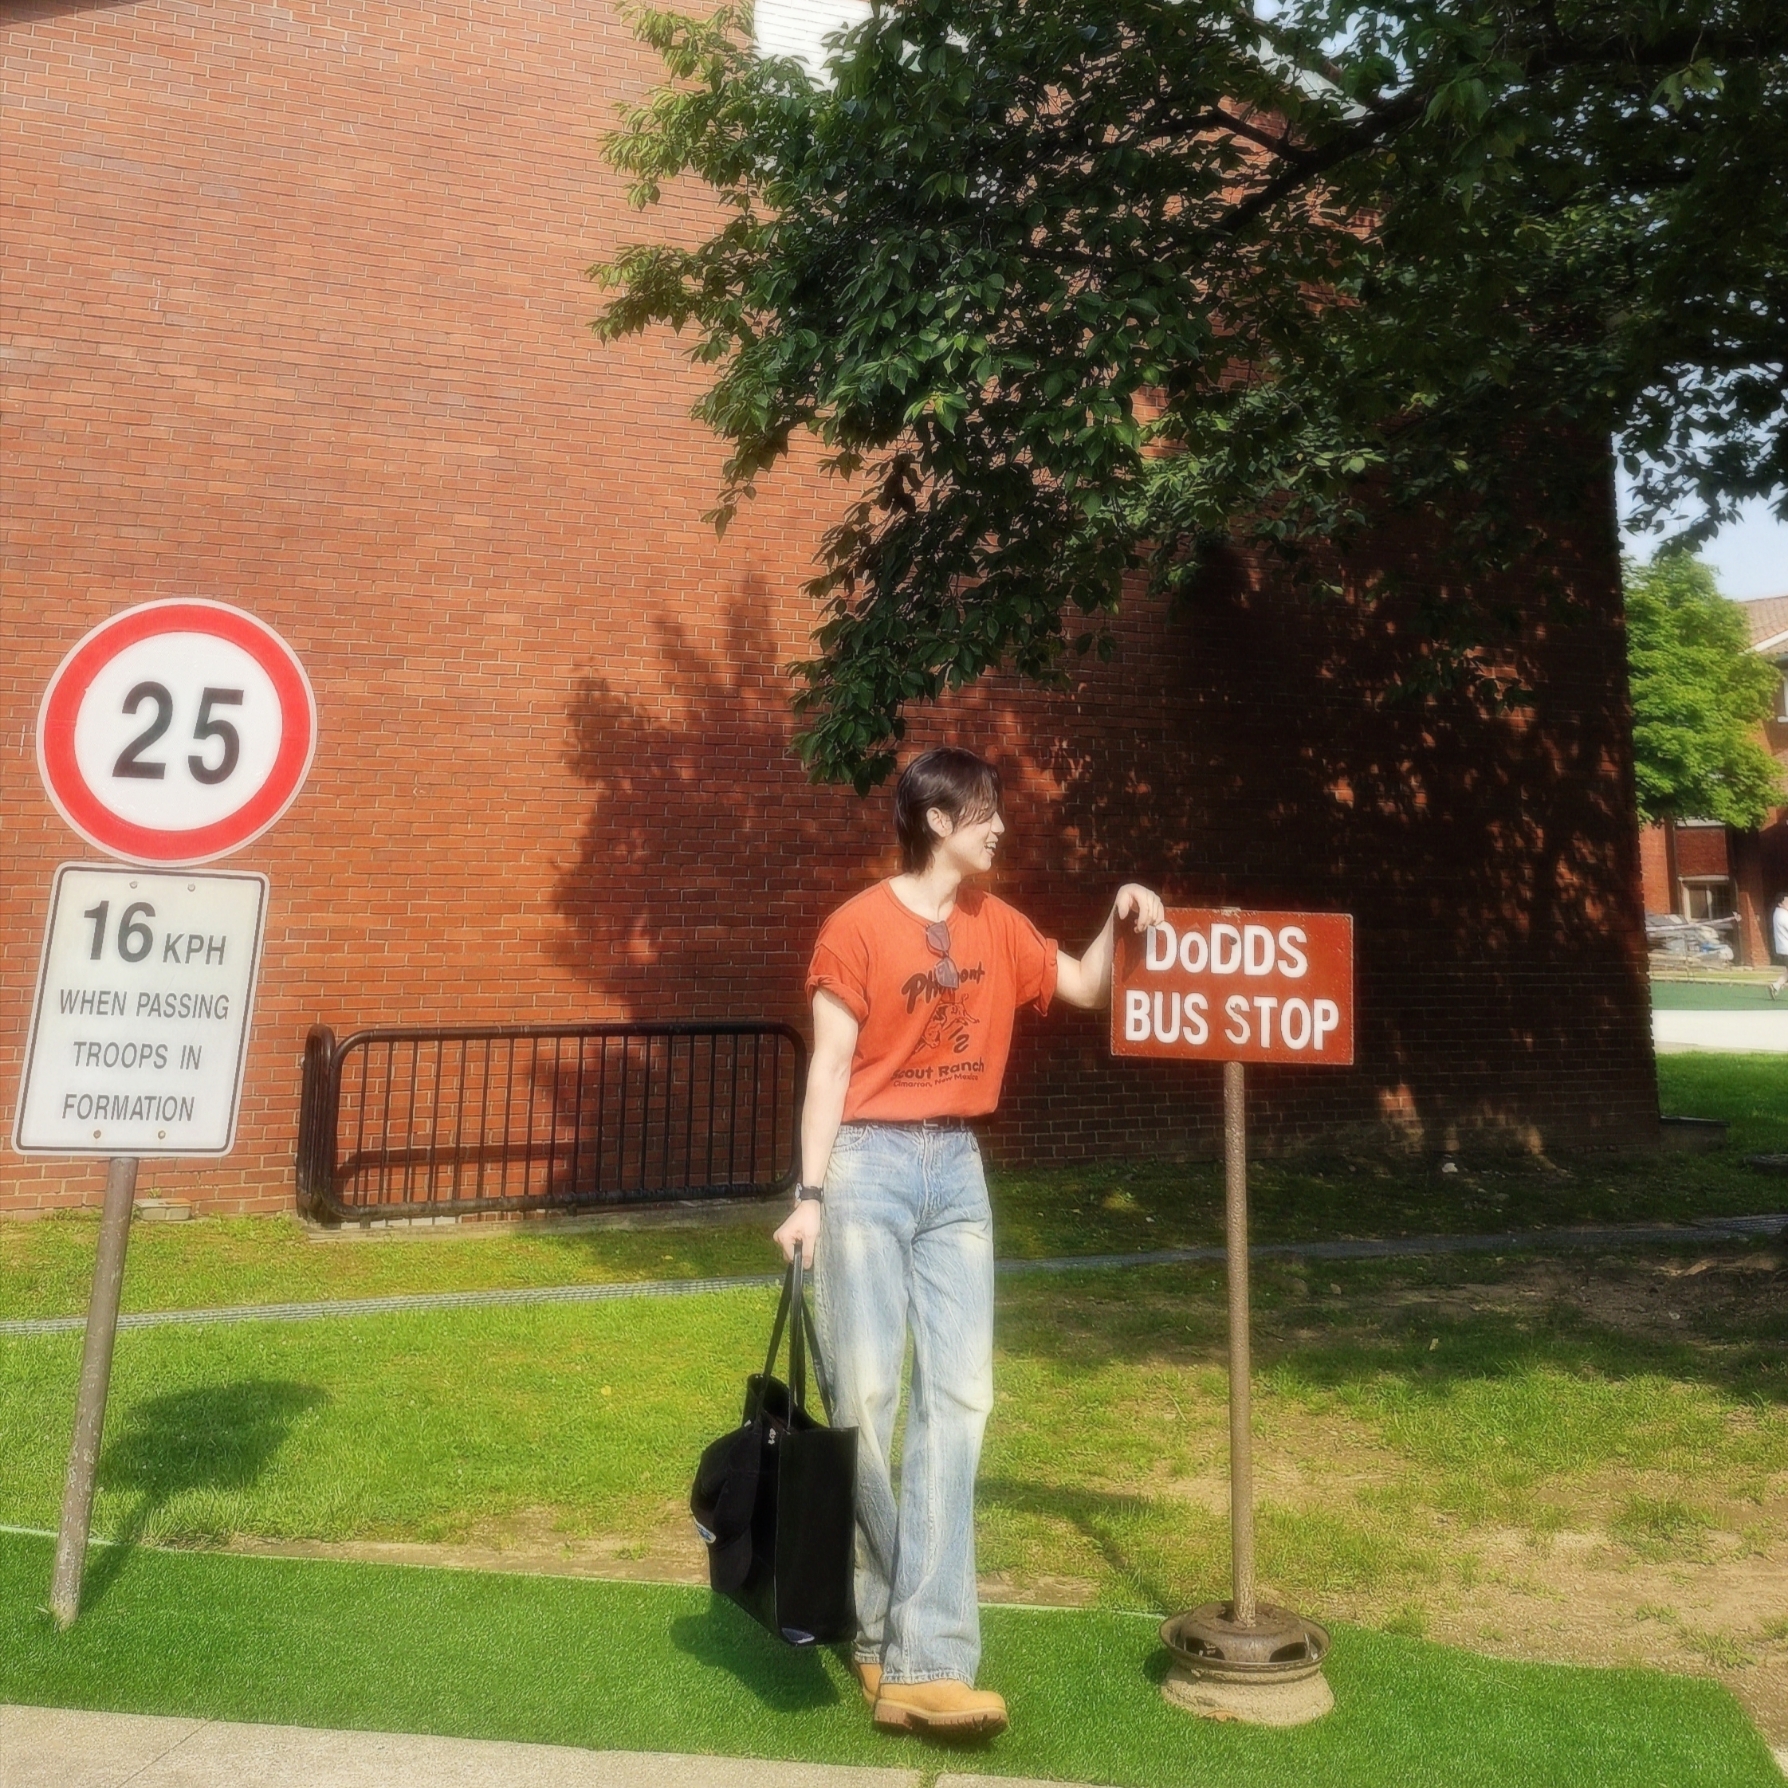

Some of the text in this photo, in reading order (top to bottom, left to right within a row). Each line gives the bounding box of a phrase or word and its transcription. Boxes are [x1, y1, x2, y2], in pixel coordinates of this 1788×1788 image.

[112, 681, 244, 785] 25
[84, 900, 227, 966] 16 KPH
[1146, 920, 1309, 978] DoDDS
[60, 989, 229, 1020] WHEN PASSING
[1125, 989, 1339, 1050] BUS STOP
[73, 1041, 202, 1070] TROOPS IN
[938, 1057, 984, 1077] Ranch
[62, 1093, 195, 1122] FORMATION
